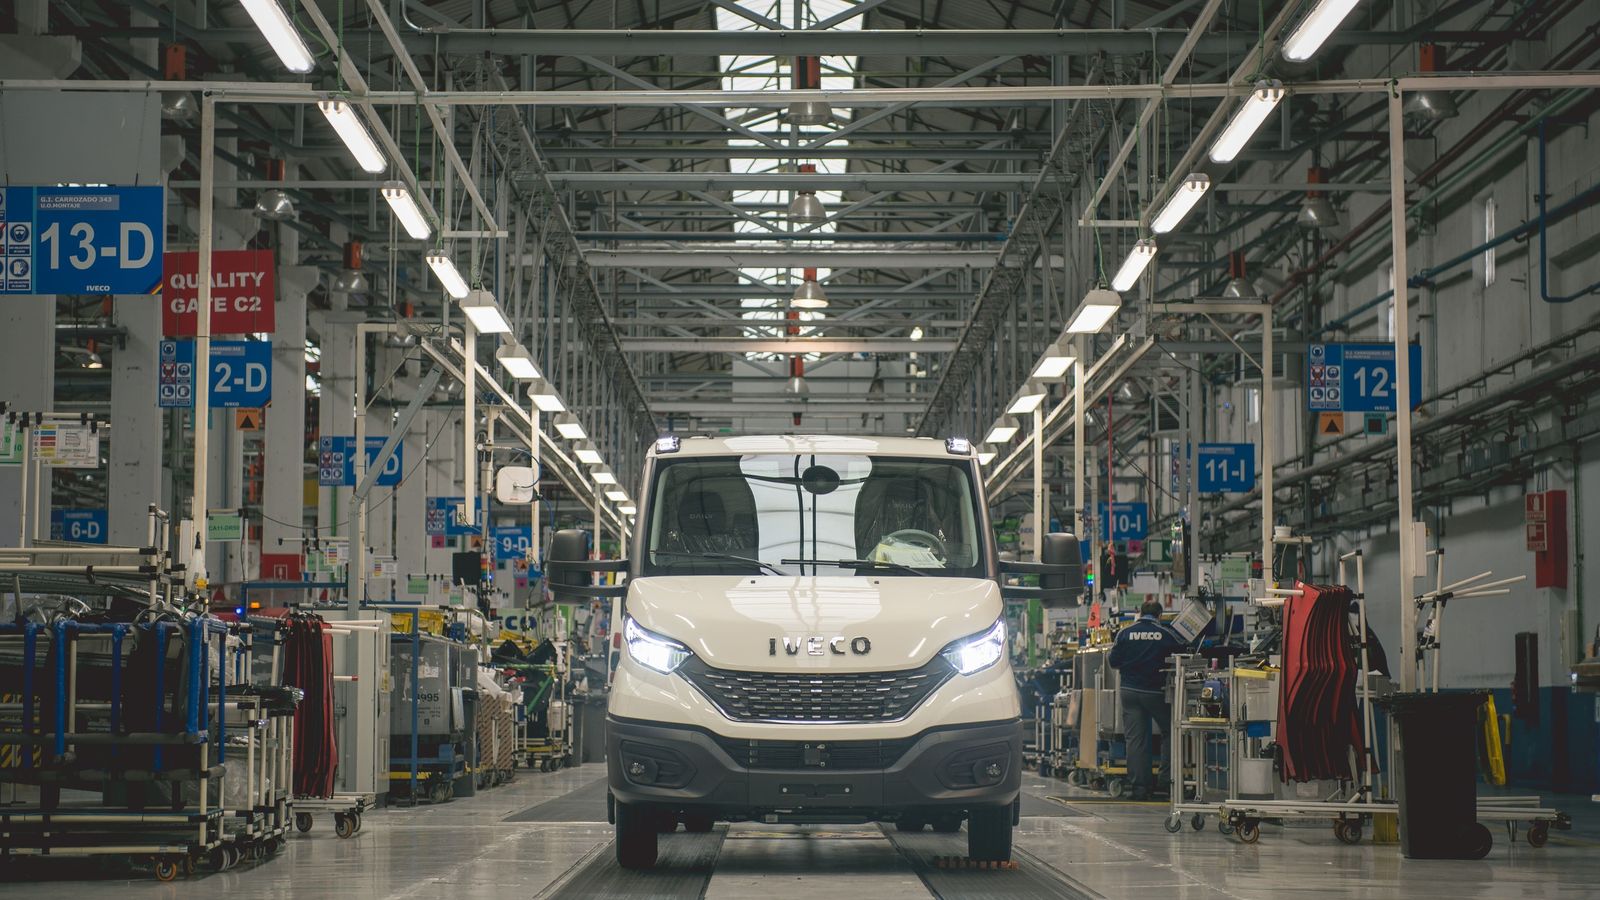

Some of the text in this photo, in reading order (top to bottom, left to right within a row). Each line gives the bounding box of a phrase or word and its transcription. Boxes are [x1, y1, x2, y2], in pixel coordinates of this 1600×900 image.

[40, 222, 154, 270] 13-D
[86, 284, 111, 292] IVECO
[170, 271, 265, 290] QULITY
[170, 296, 262, 314] GAE C2
[214, 362, 267, 392] 2-D
[1353, 366, 1397, 397] 12-
[348, 452, 400, 475] 11D
[1205, 459, 1246, 483] 11-I
[71, 521, 100, 539] 6-D
[1112, 515, 1142, 533] 10-I
[502, 536, 529, 553] 9-D
[1129, 631, 1163, 641] IVECO
[769, 636, 872, 656] IVECO
